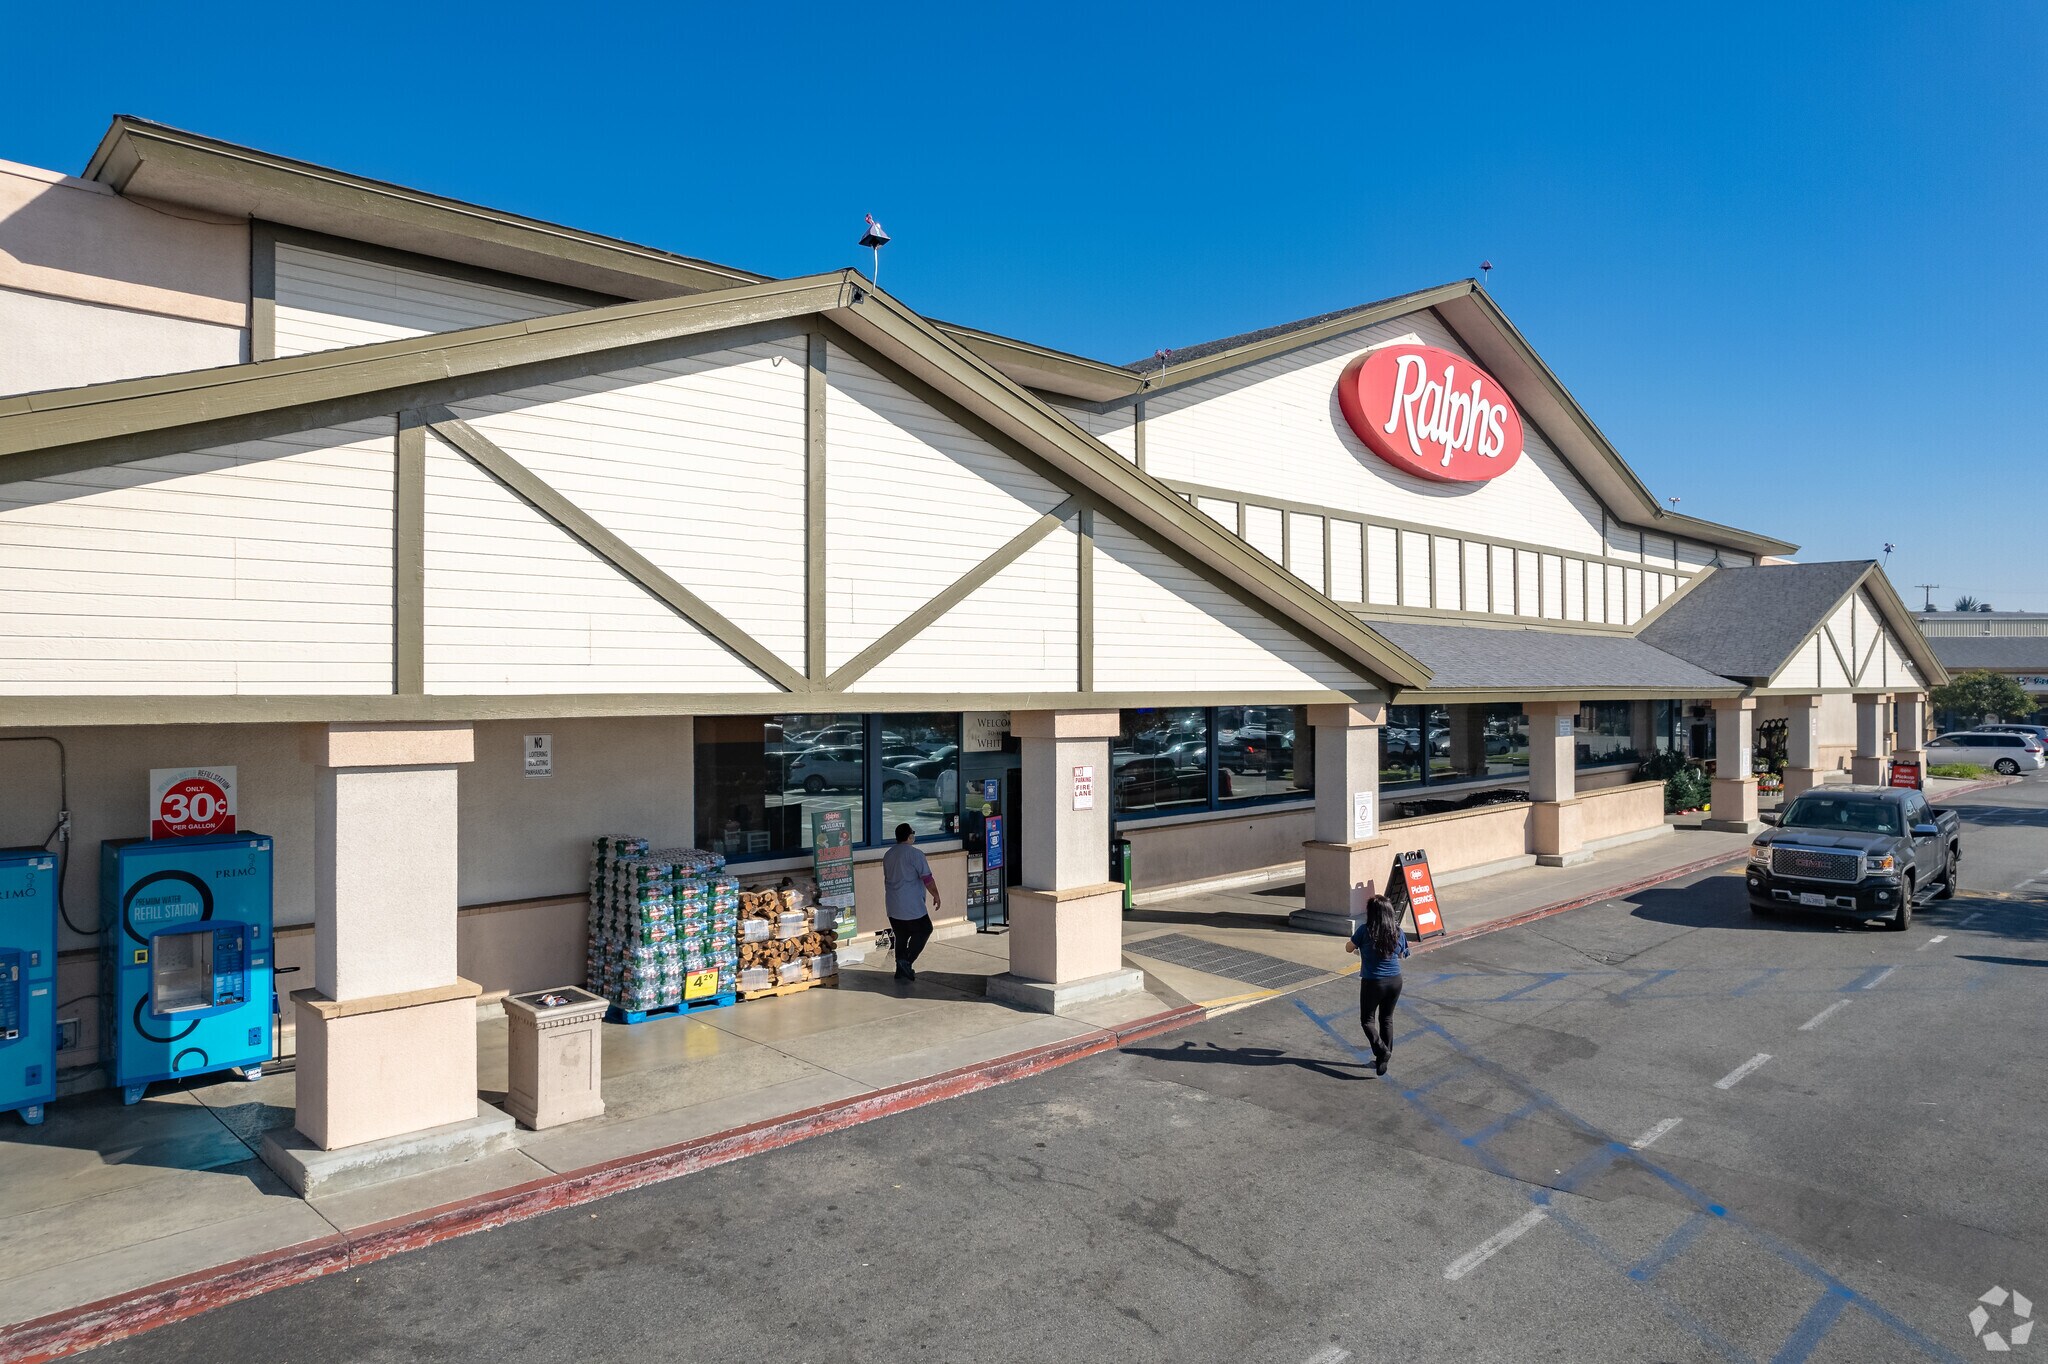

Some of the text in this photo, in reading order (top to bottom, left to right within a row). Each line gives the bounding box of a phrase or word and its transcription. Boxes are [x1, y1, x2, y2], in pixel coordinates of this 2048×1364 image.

[1383, 354, 1508, 467] Ralphs
[977, 718, 1011, 728] WELCO
[534, 737, 543, 748] NO
[977, 739, 1001, 748] WHIT
[1074, 767, 1083, 777] NO
[197, 769, 215, 781] REFILL
[213, 772, 231, 790] STATION
[162, 792, 227, 824] 30¢
[187, 822, 216, 830] GALLON
[820, 822, 846, 830] TAILGATE
[215, 866, 257, 879] PRIMO
[818, 877, 853, 888] HOME GAMES
[0, 888, 37, 900] IMO
[1410, 885, 1430, 895] Pickup
[135, 895, 182, 906] PREMIUM WATER
[1412, 894, 1433, 905] SERVICE
[134, 902, 199, 921] REFILL STATION
